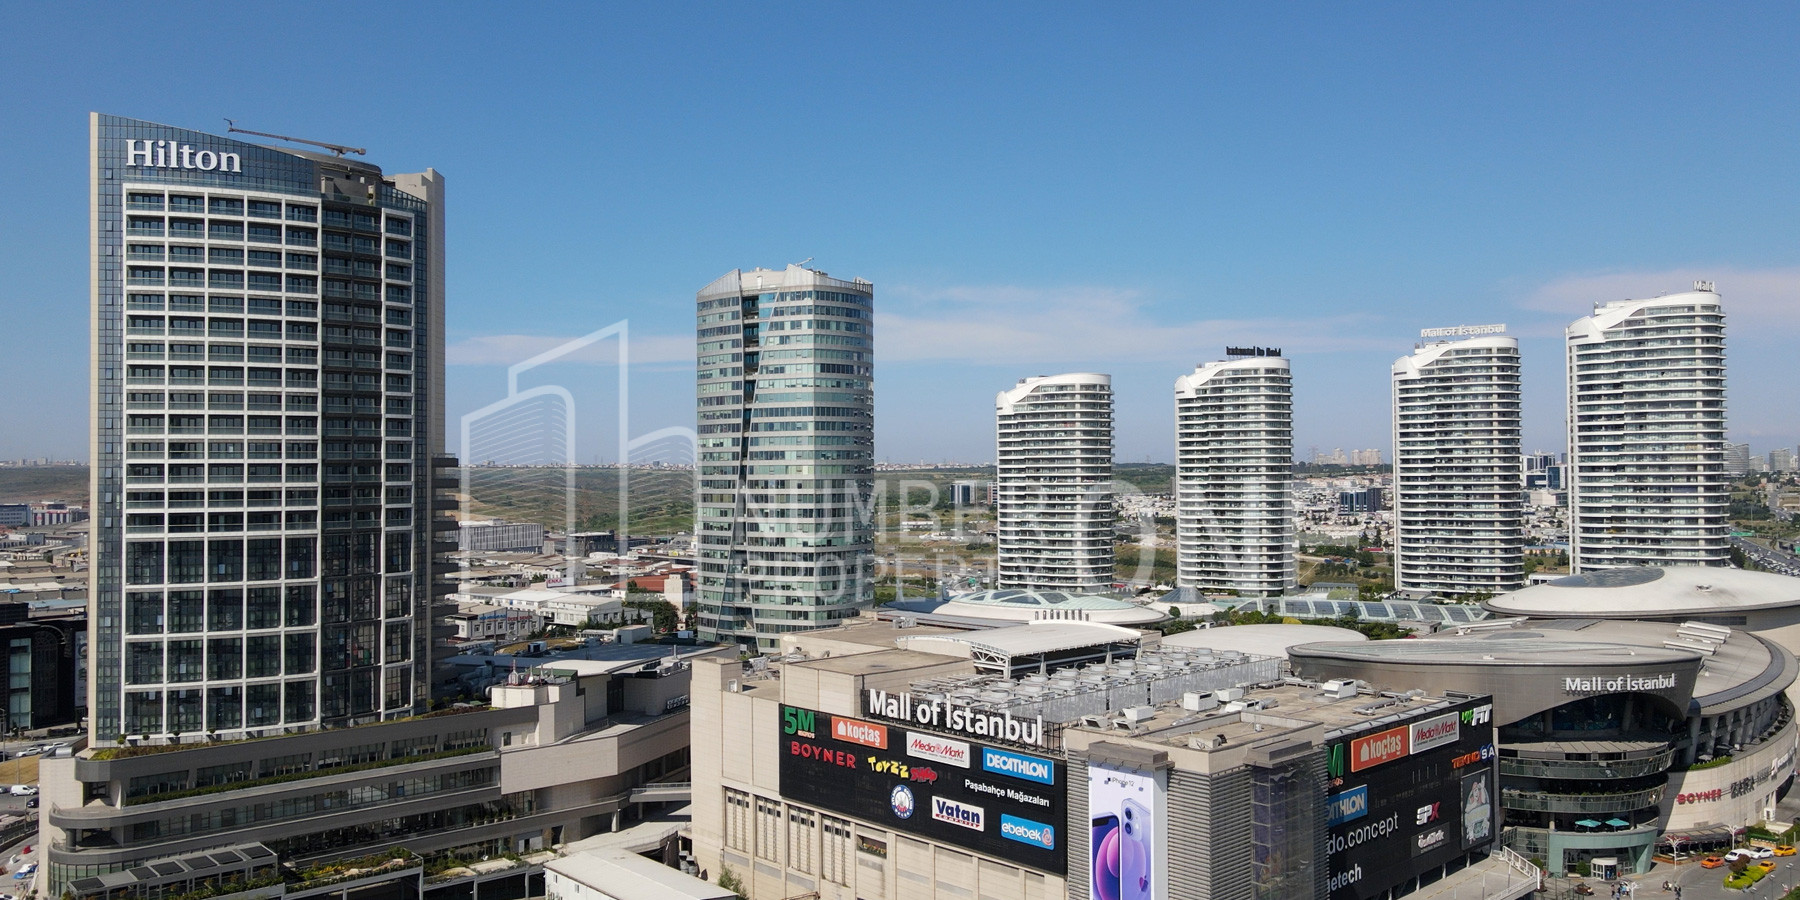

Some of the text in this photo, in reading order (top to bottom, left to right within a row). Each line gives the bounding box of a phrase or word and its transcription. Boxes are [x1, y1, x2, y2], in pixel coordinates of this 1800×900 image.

[126, 139, 242, 173] Hilton
[1421, 328, 1442, 338] Mall
[1445, 328, 1457, 336] of
[1565, 676, 1602, 691] Mall
[1606, 676, 1624, 691] of
[784, 706, 816, 735] 5M
[869, 688, 911, 721] Mall
[916, 699, 940, 727] of
[846, 721, 880, 746] koçtaş
[791, 740, 856, 769] BOYNER
[1370, 734, 1402, 760] koçtaş
[986, 752, 1048, 779] DECATHLON
[964, 778, 1050, 807] Paşabahçe Mağazaları
[1677, 788, 1722, 804] BOYNER
[936, 799, 980, 824] Vatan
[1327, 793, 1366, 821] ATHLON
[1416, 801, 1441, 826] SPX
[1002, 821, 1042, 842] ebebek
